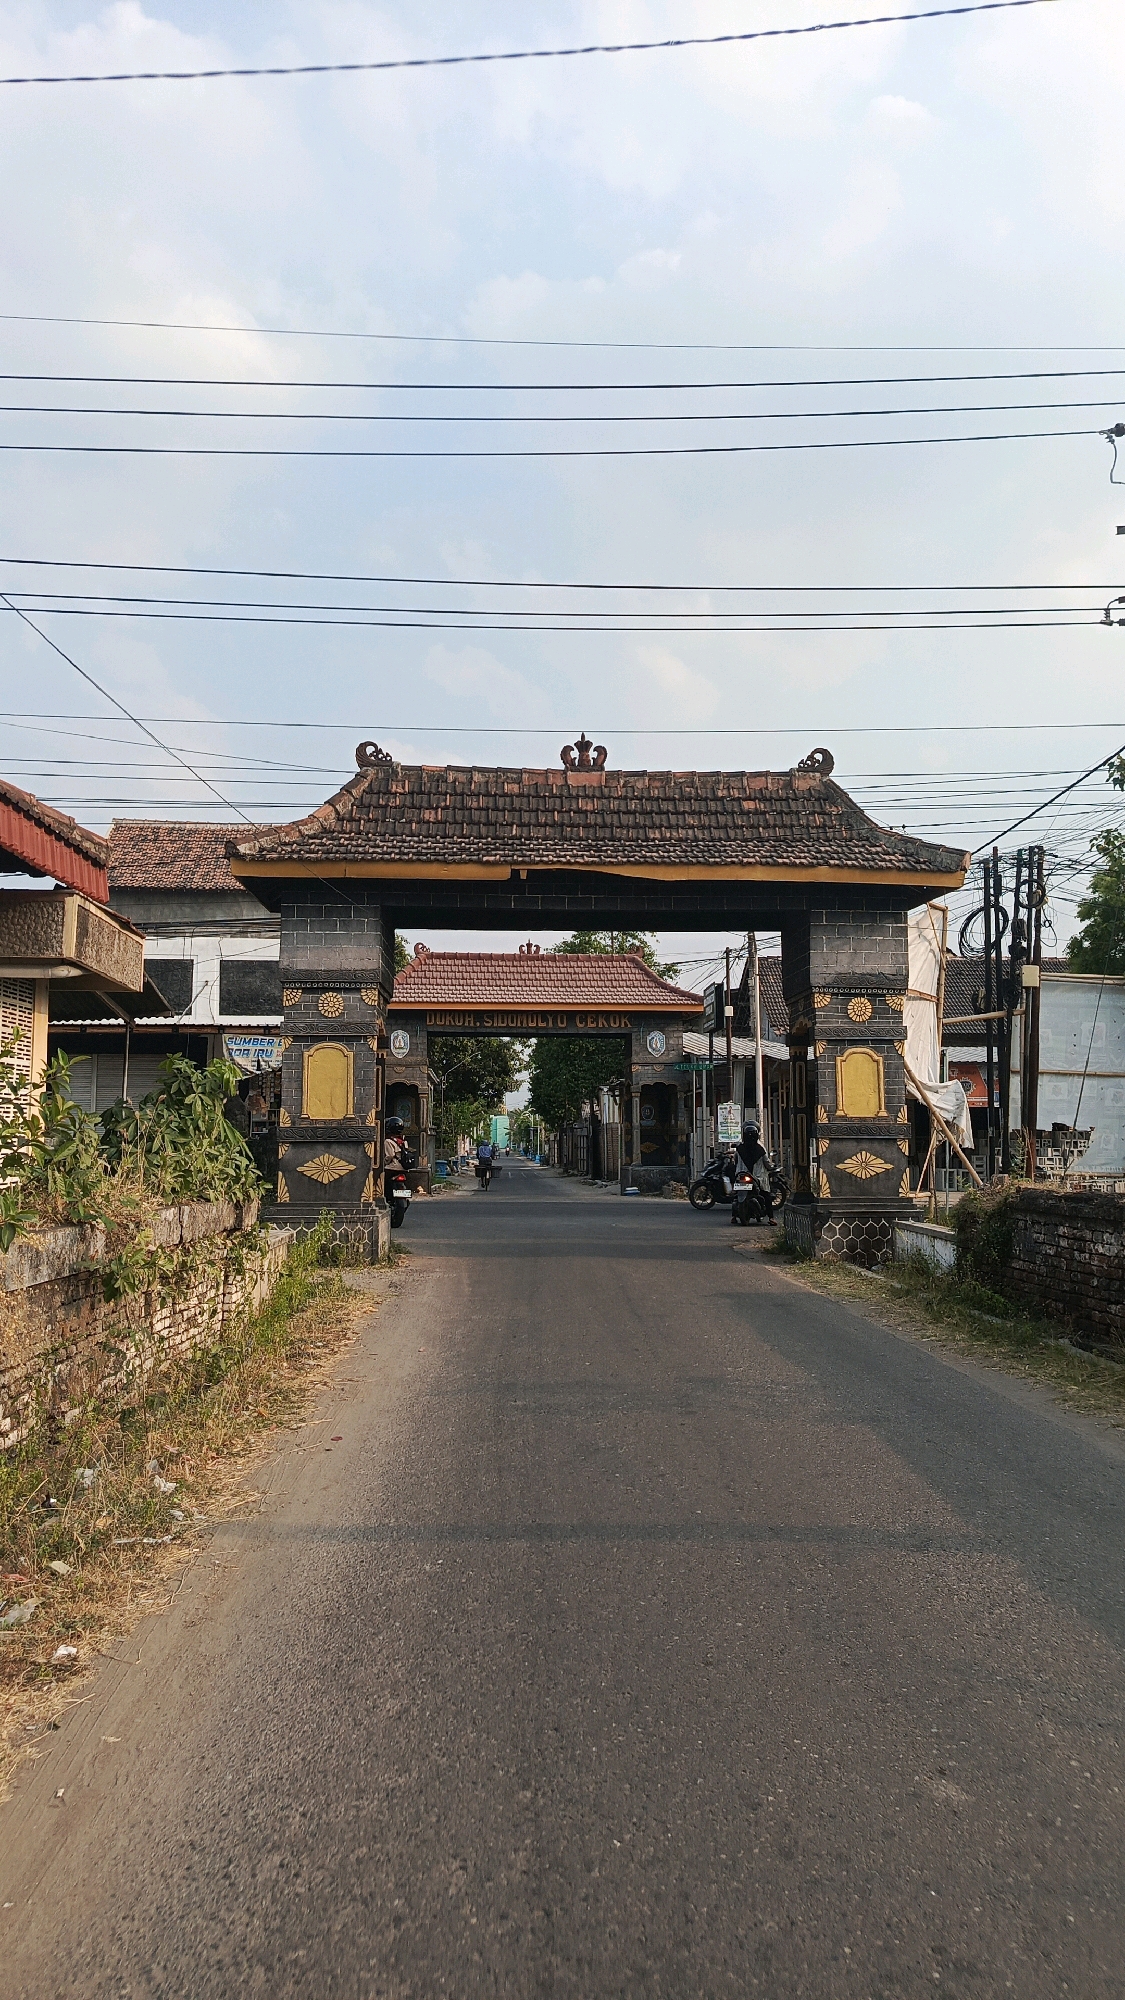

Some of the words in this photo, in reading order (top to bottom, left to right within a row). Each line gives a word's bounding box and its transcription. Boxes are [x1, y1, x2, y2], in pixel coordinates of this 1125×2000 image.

[483, 1012, 567, 1028] SIDOMULYO
[575, 1013, 632, 1028] CEKOK
[227, 1037, 274, 1046] SUMBER
